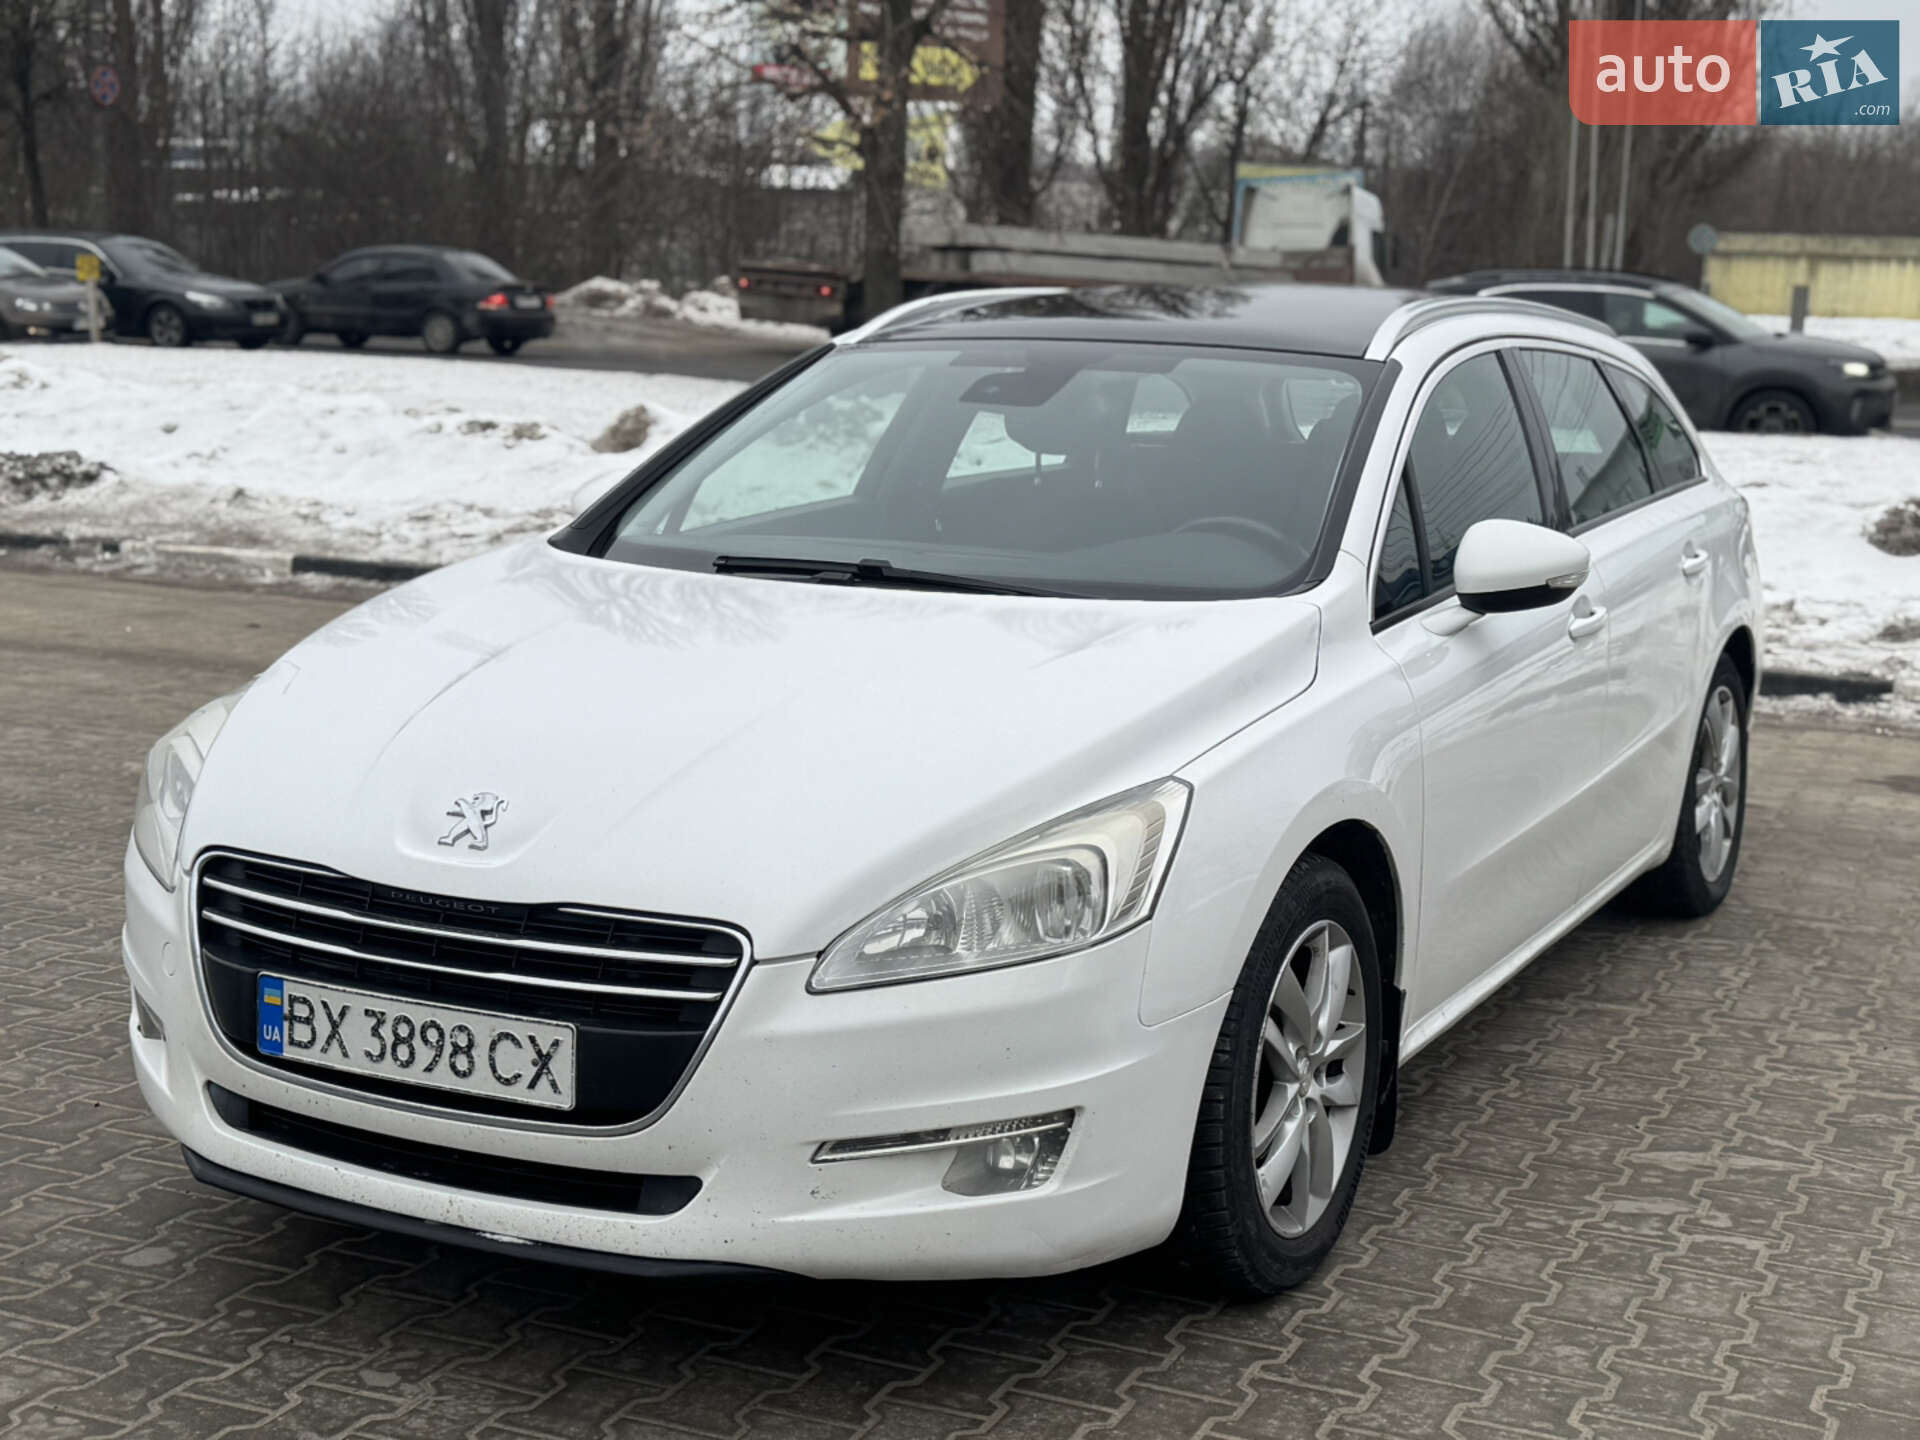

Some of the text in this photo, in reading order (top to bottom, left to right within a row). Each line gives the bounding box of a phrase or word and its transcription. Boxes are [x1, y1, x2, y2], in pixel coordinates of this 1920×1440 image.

[391, 891, 501, 914] PEUGEOT
[263, 1023, 281, 1042] UA
[287, 993, 563, 1095] BX 3898 CX
